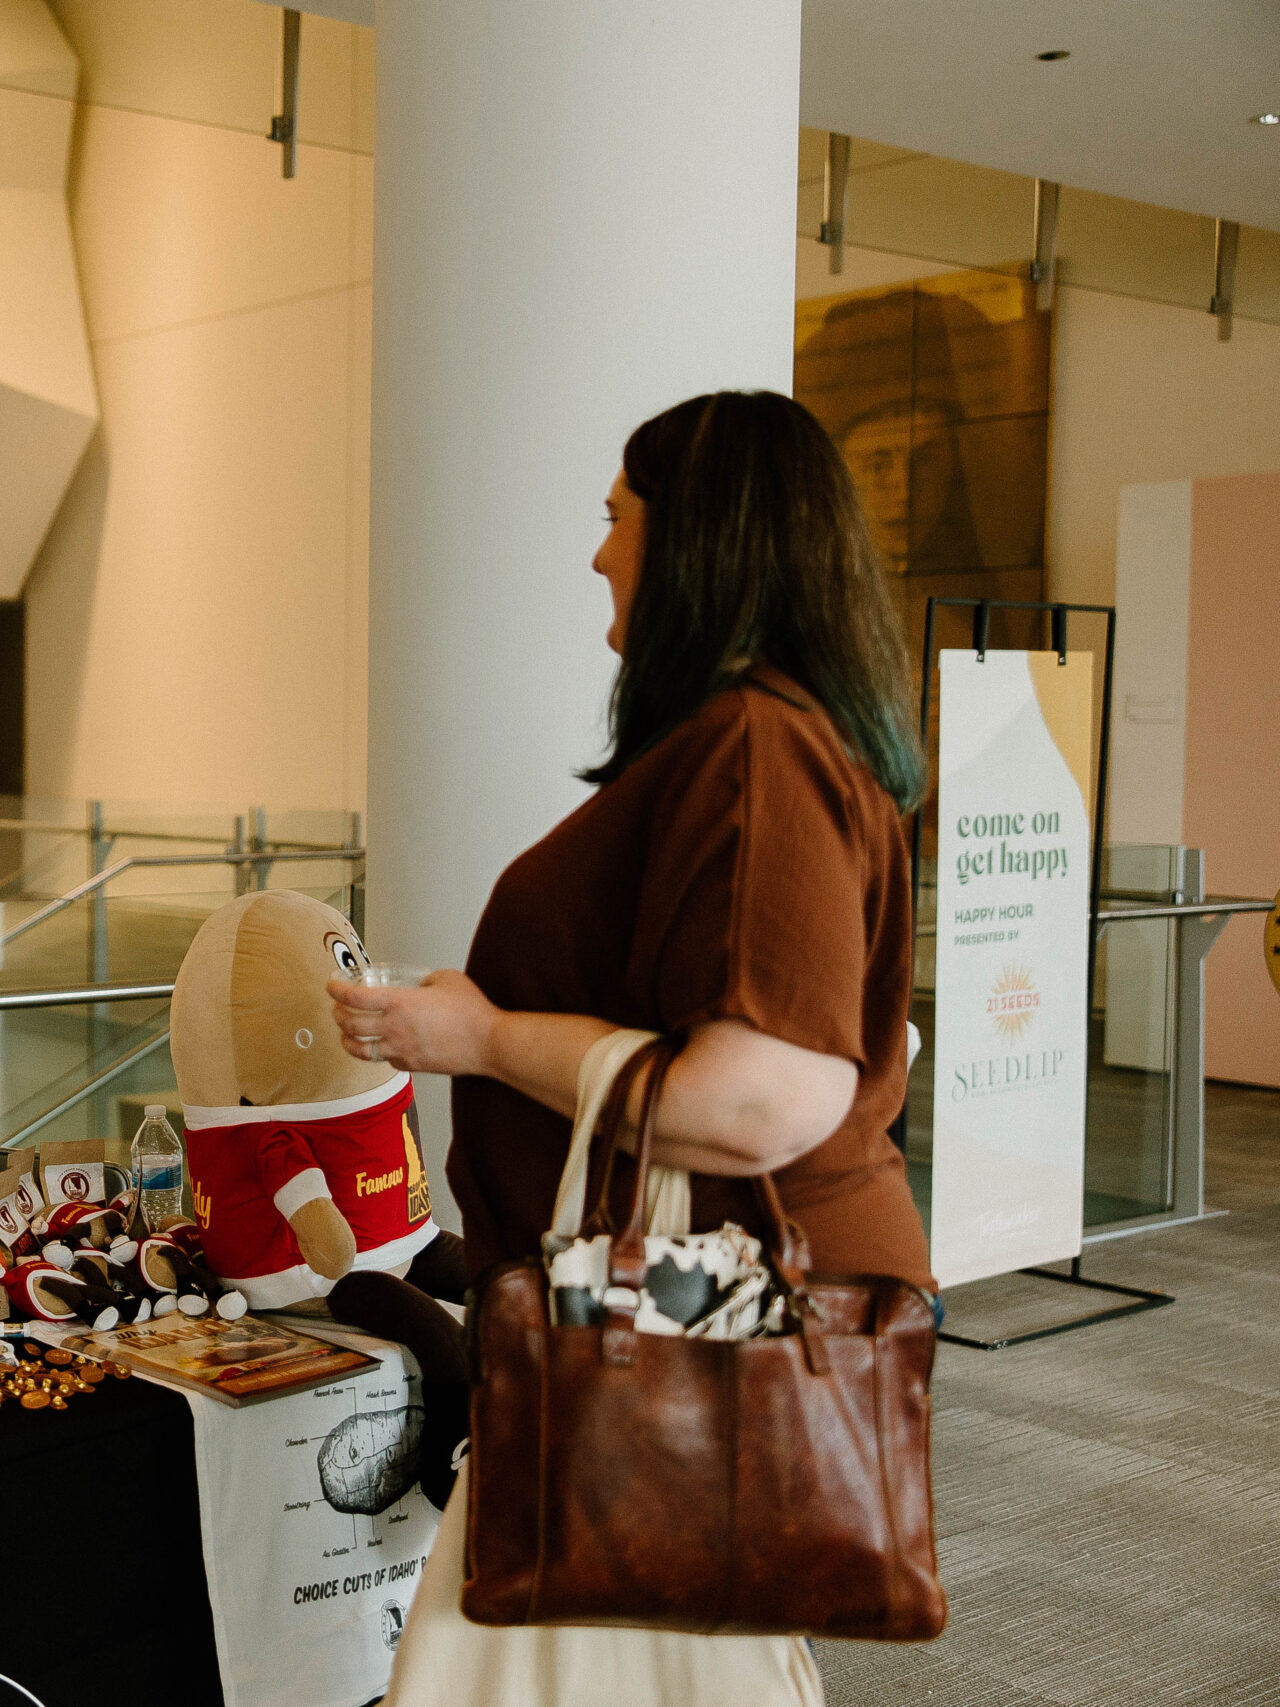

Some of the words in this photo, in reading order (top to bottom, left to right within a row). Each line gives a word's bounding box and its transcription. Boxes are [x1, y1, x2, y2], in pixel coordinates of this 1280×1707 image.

[957, 813, 1025, 838] come
[1032, 811, 1059, 834] on
[956, 846, 993, 885] get
[1000, 841, 1067, 880] happy
[954, 906, 995, 924] HAPPY
[999, 903, 1033, 920] HOUR
[954, 931, 1005, 946] PRESENTED
[356, 1166, 404, 1197] Famous
[118, 1318, 231, 1350] IDAHO
[294, 1578, 339, 1605] CHOICE
[343, 1572, 372, 1595] CUTS
[374, 1567, 386, 1587] OF
